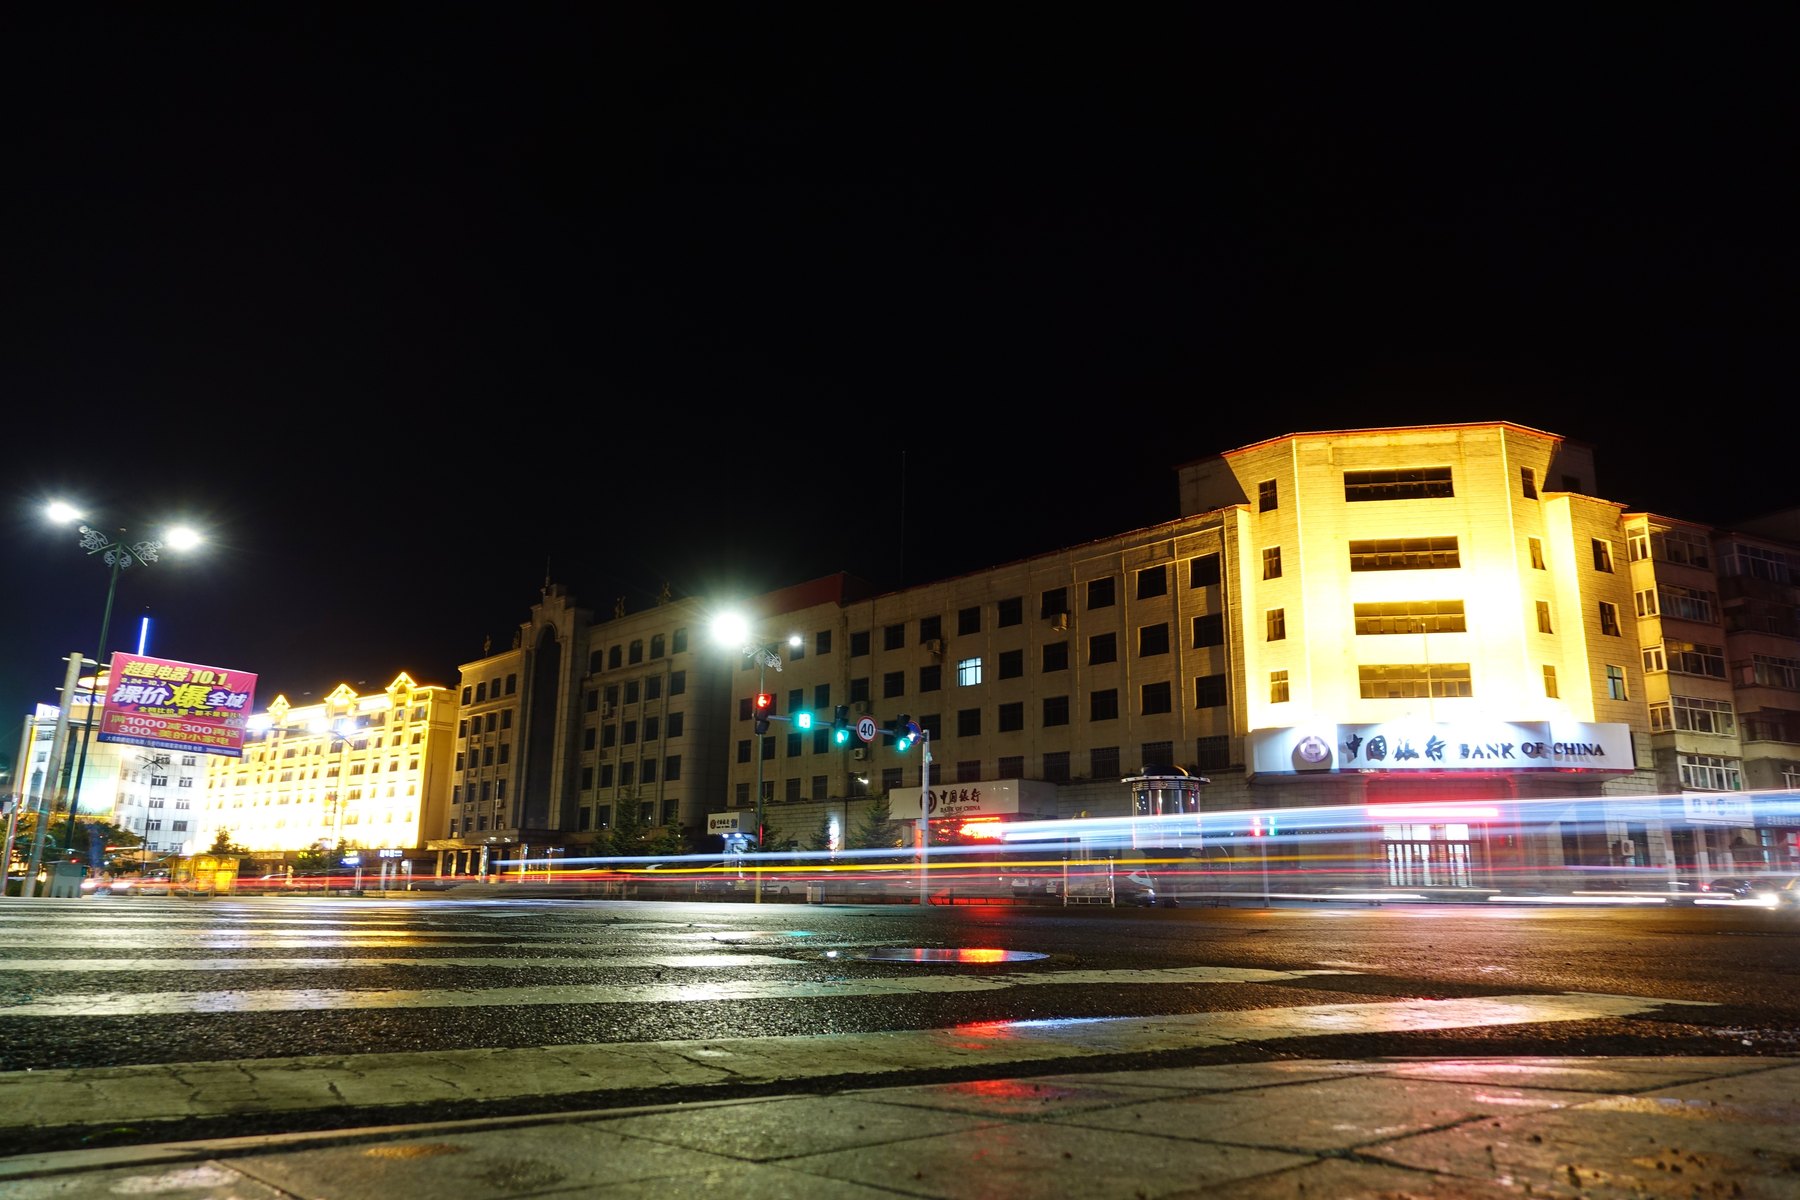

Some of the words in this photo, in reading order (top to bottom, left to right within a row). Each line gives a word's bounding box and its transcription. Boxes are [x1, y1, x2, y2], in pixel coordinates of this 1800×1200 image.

[191, 670, 228, 686] 10.1
[860, 723, 874, 737] 40
[1344, 733, 1446, 762] 中国银行
[1458, 743, 1515, 760] BANK
[1521, 741, 1544, 755] OF
[1552, 742, 1606, 757] CHINA
[939, 787, 982, 805] 中国银行
